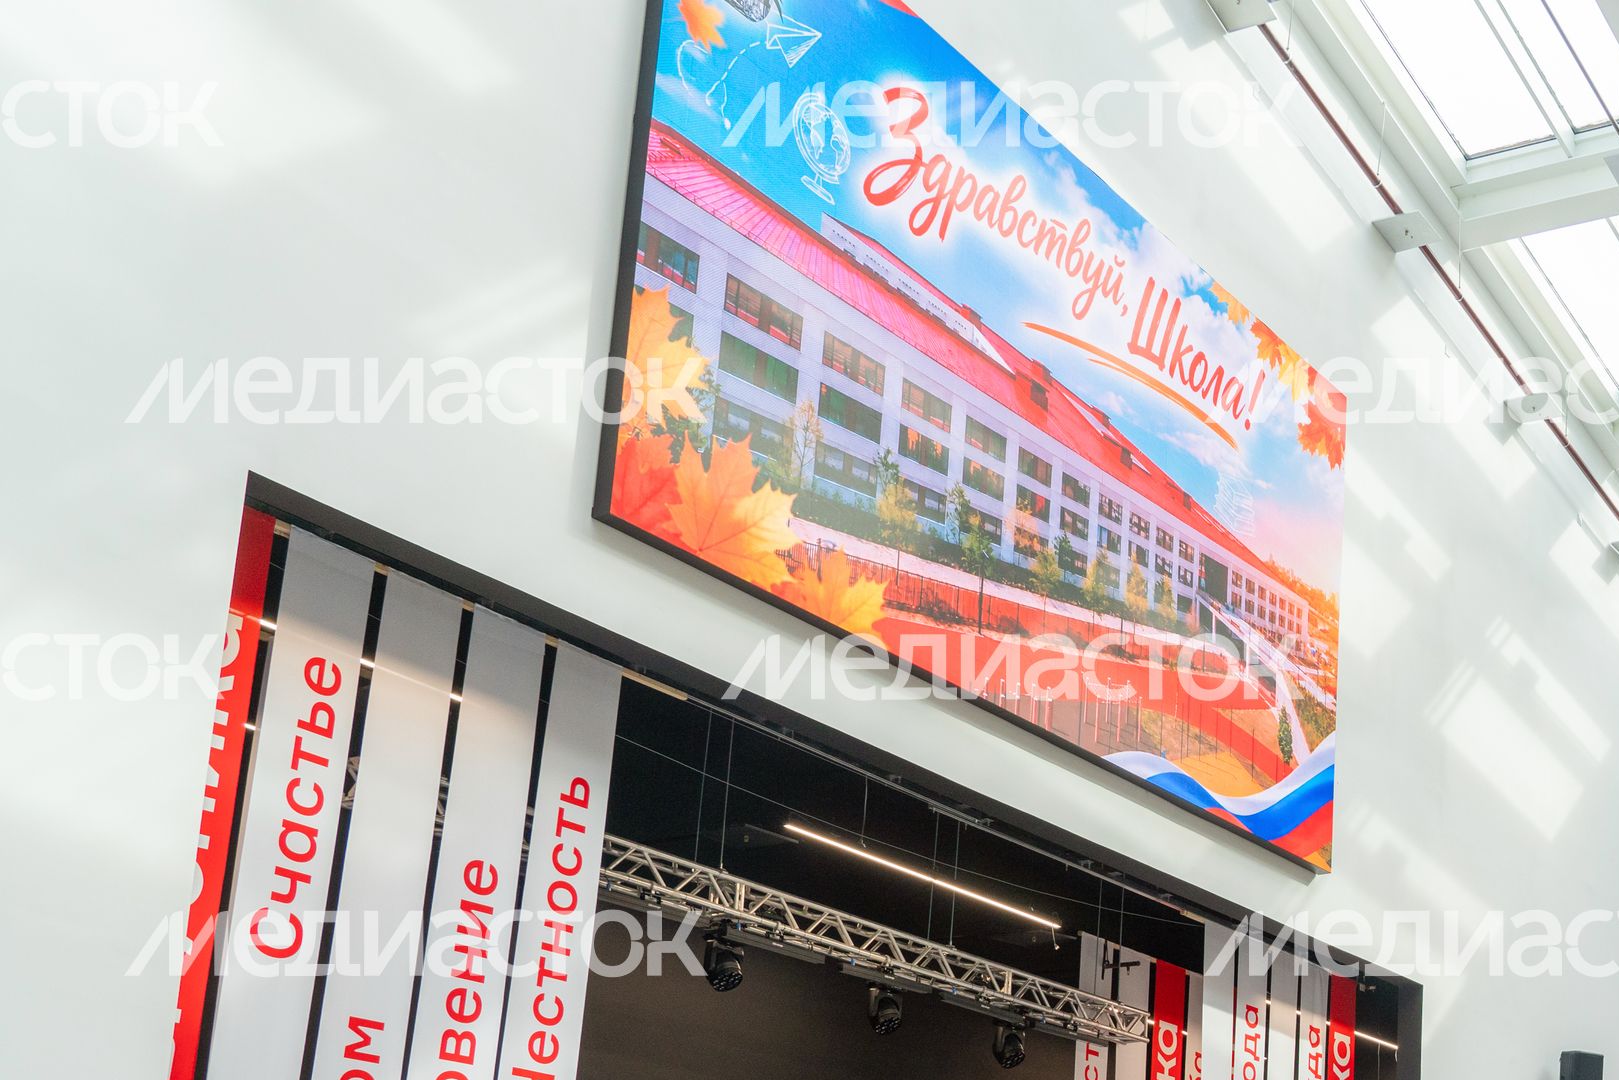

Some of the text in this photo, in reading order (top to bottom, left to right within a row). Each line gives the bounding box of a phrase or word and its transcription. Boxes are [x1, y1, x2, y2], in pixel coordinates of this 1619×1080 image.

[862, 87, 1267, 432] Здравствуй, Школа!
[250, 656, 342, 960] Счастье
